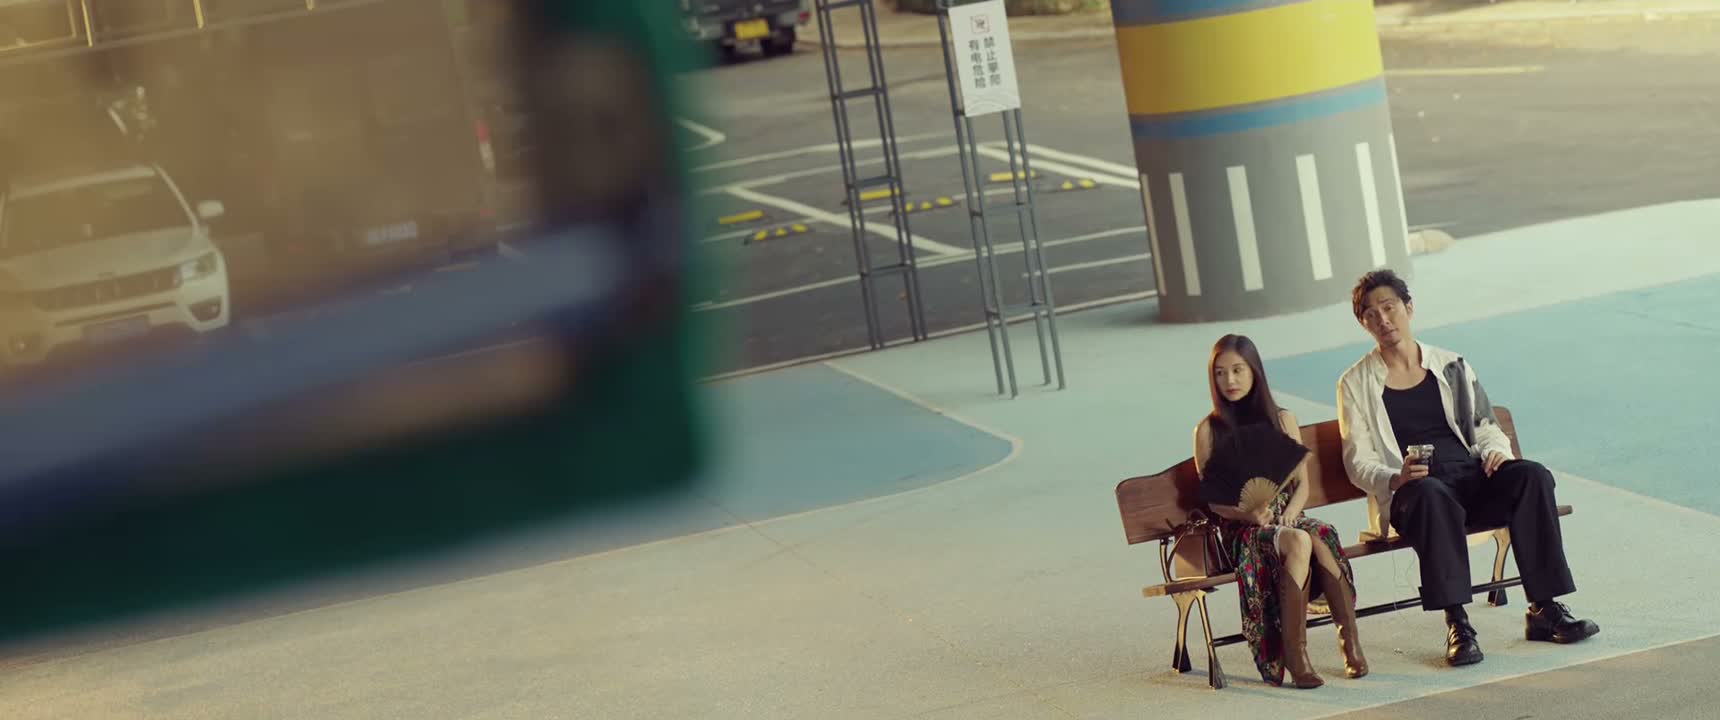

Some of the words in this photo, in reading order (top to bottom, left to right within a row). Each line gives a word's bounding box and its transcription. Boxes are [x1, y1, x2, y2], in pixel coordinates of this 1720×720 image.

[968, 39, 986, 88] 有电危险
[984, 36, 1001, 86] 禁止攀爬
